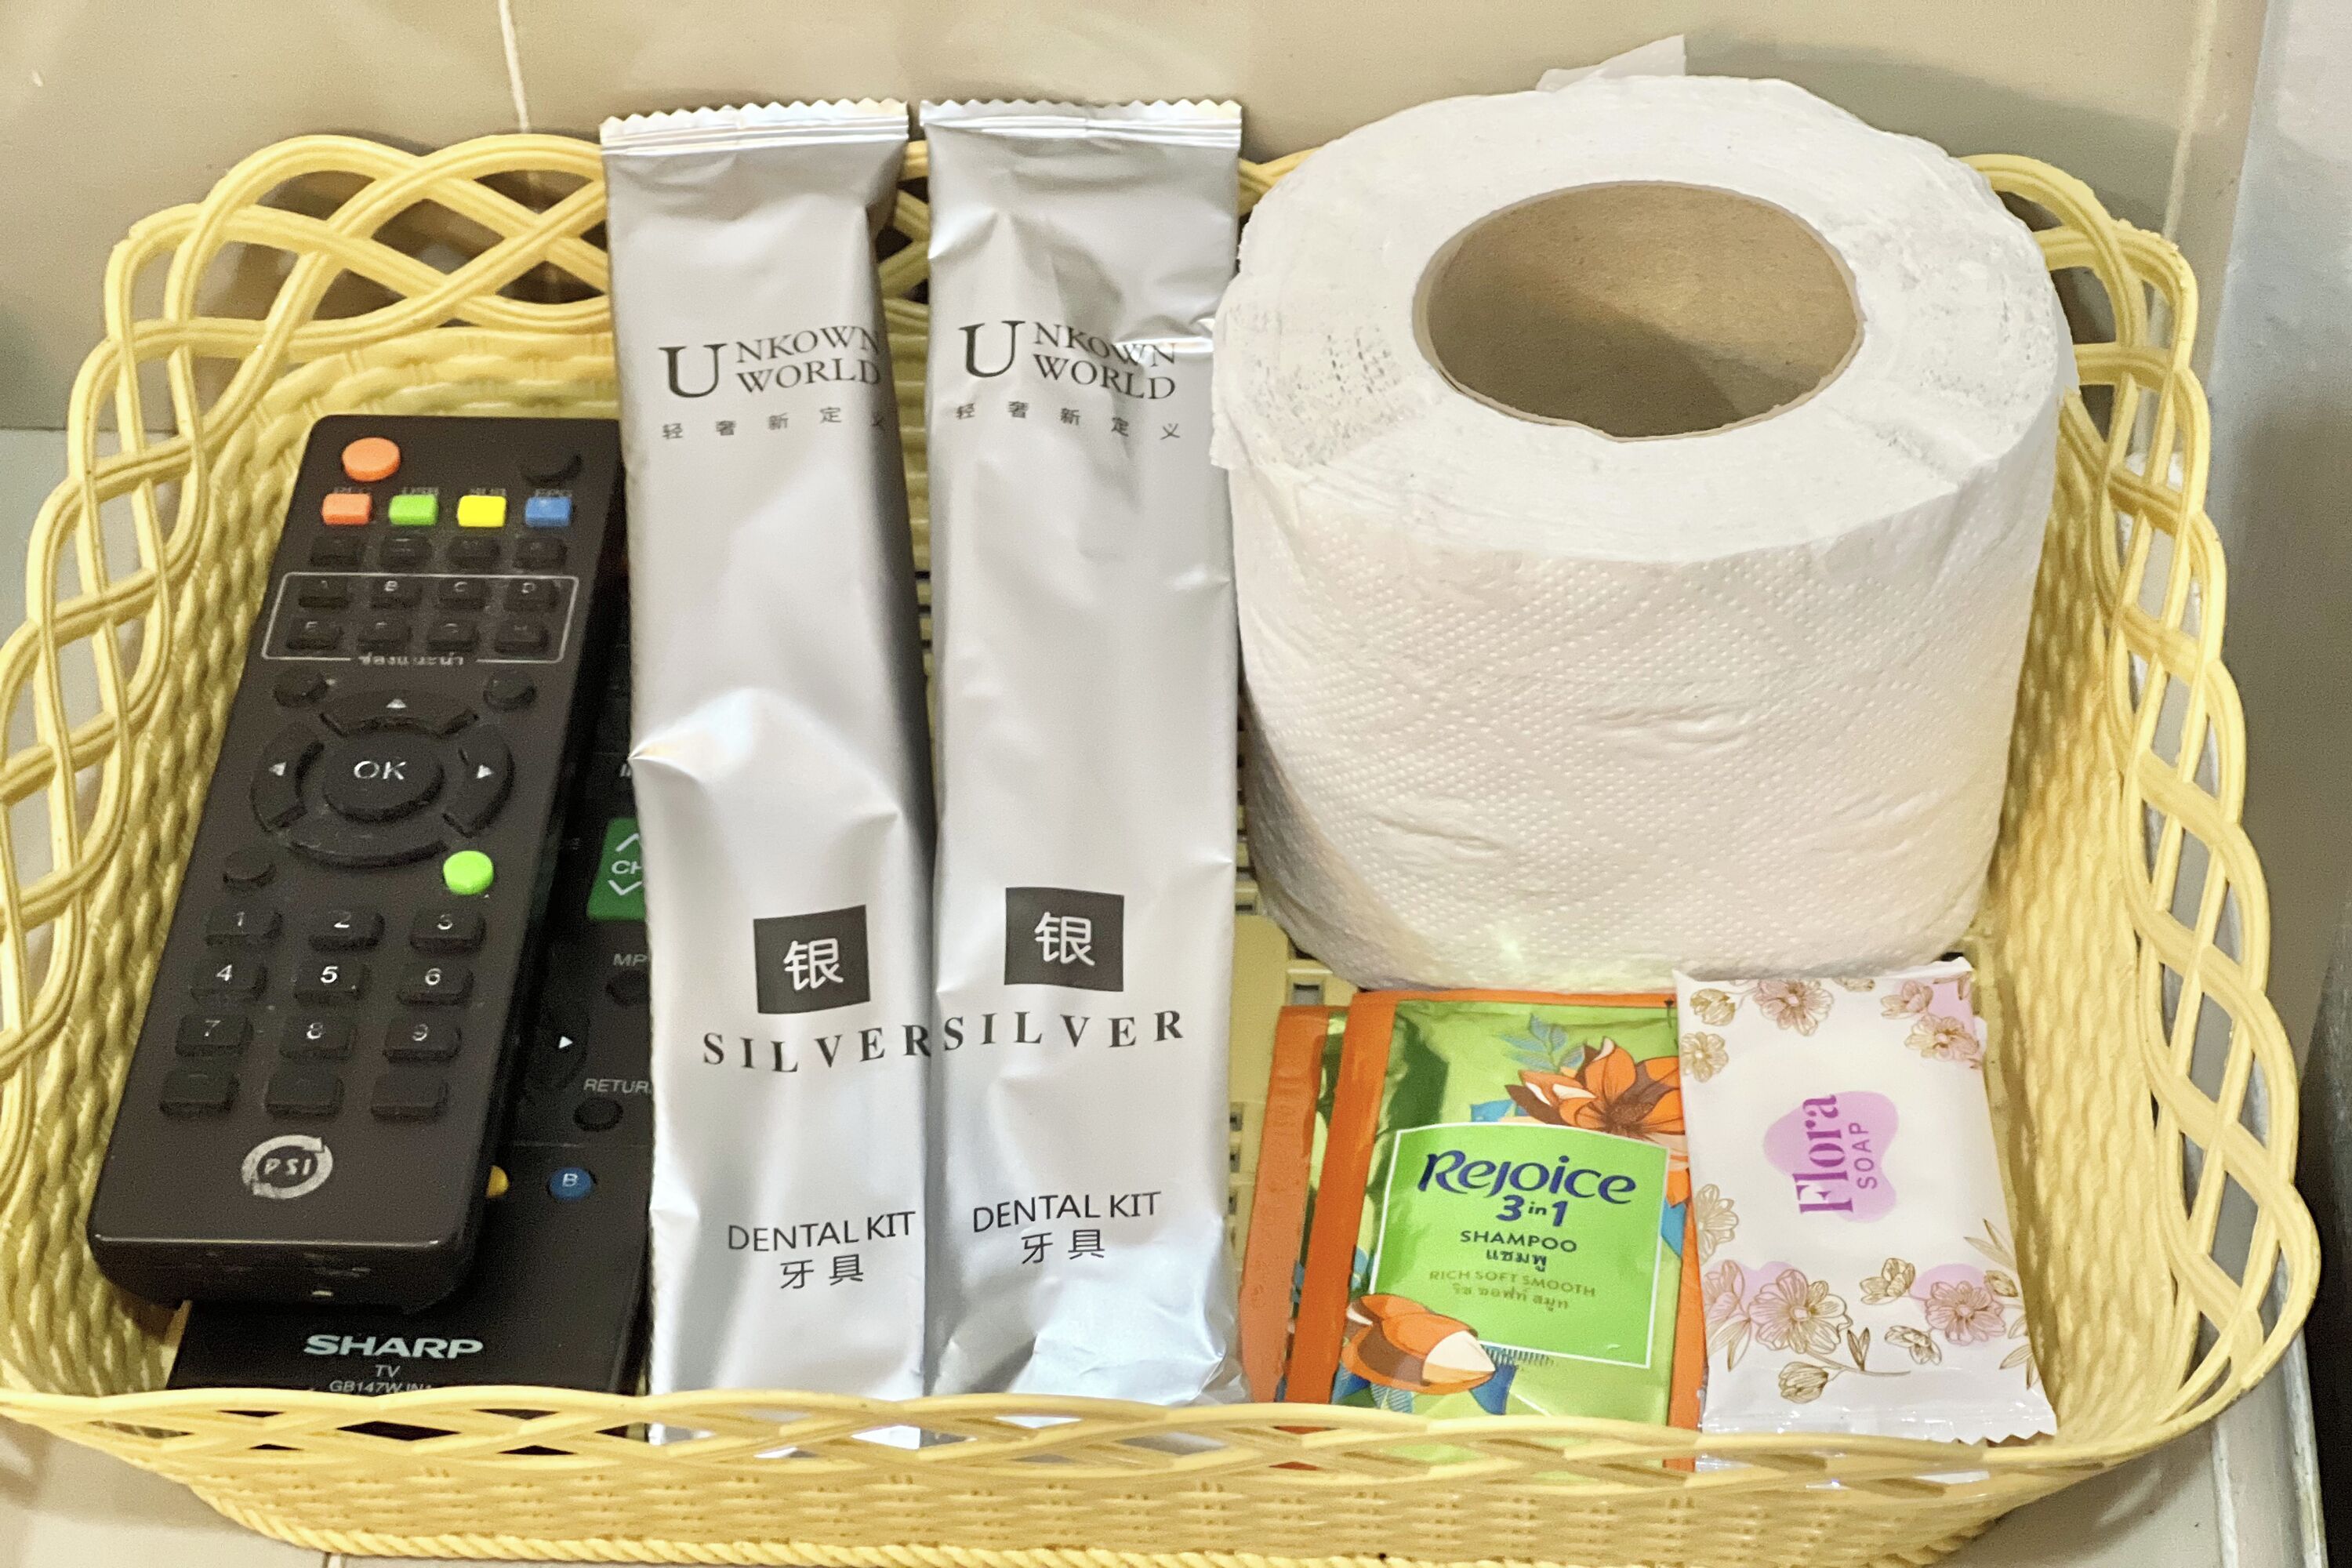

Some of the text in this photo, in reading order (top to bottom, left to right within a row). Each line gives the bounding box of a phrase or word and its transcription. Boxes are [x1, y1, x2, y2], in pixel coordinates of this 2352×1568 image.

[735, 358, 882, 394] WORLD
[1033, 354, 1176, 400] WORLD
[353, 760, 408, 781] OK
[333, 909, 353, 928] 2
[1035, 912, 1094, 966] 银
[216, 964, 442, 985] 4 5 6
[782, 938, 844, 991] 银
[203, 1019, 222, 1037] 7
[306, 1022, 325, 1040] 8
[943, 1010, 1184, 1051] SILVER
[702, 1025, 931, 1073] SILVER
[263, 1156, 314, 1177] PSI
[1792, 1094, 1853, 1213] Flora
[1848, 1122, 1878, 1189] SOAP
[562, 1173, 579, 1186] B
[972, 1192, 1162, 1232] DENTAL KIT
[1496, 1193, 1568, 1227] 3 in 1
[727, 1211, 916, 1252] DENTAL KIT
[1021, 1229, 1105, 1265] 牙具
[1460, 1230, 1577, 1253] SHAMPOO
[780, 1254, 864, 1289] 牙具
[1486, 1249, 1547, 1272] แชมพู
[1429, 1269, 1596, 1298] RICH SOFT SMOOTH
[303, 1334, 484, 1359] SHARP
[374, 1364, 401, 1377] TV
